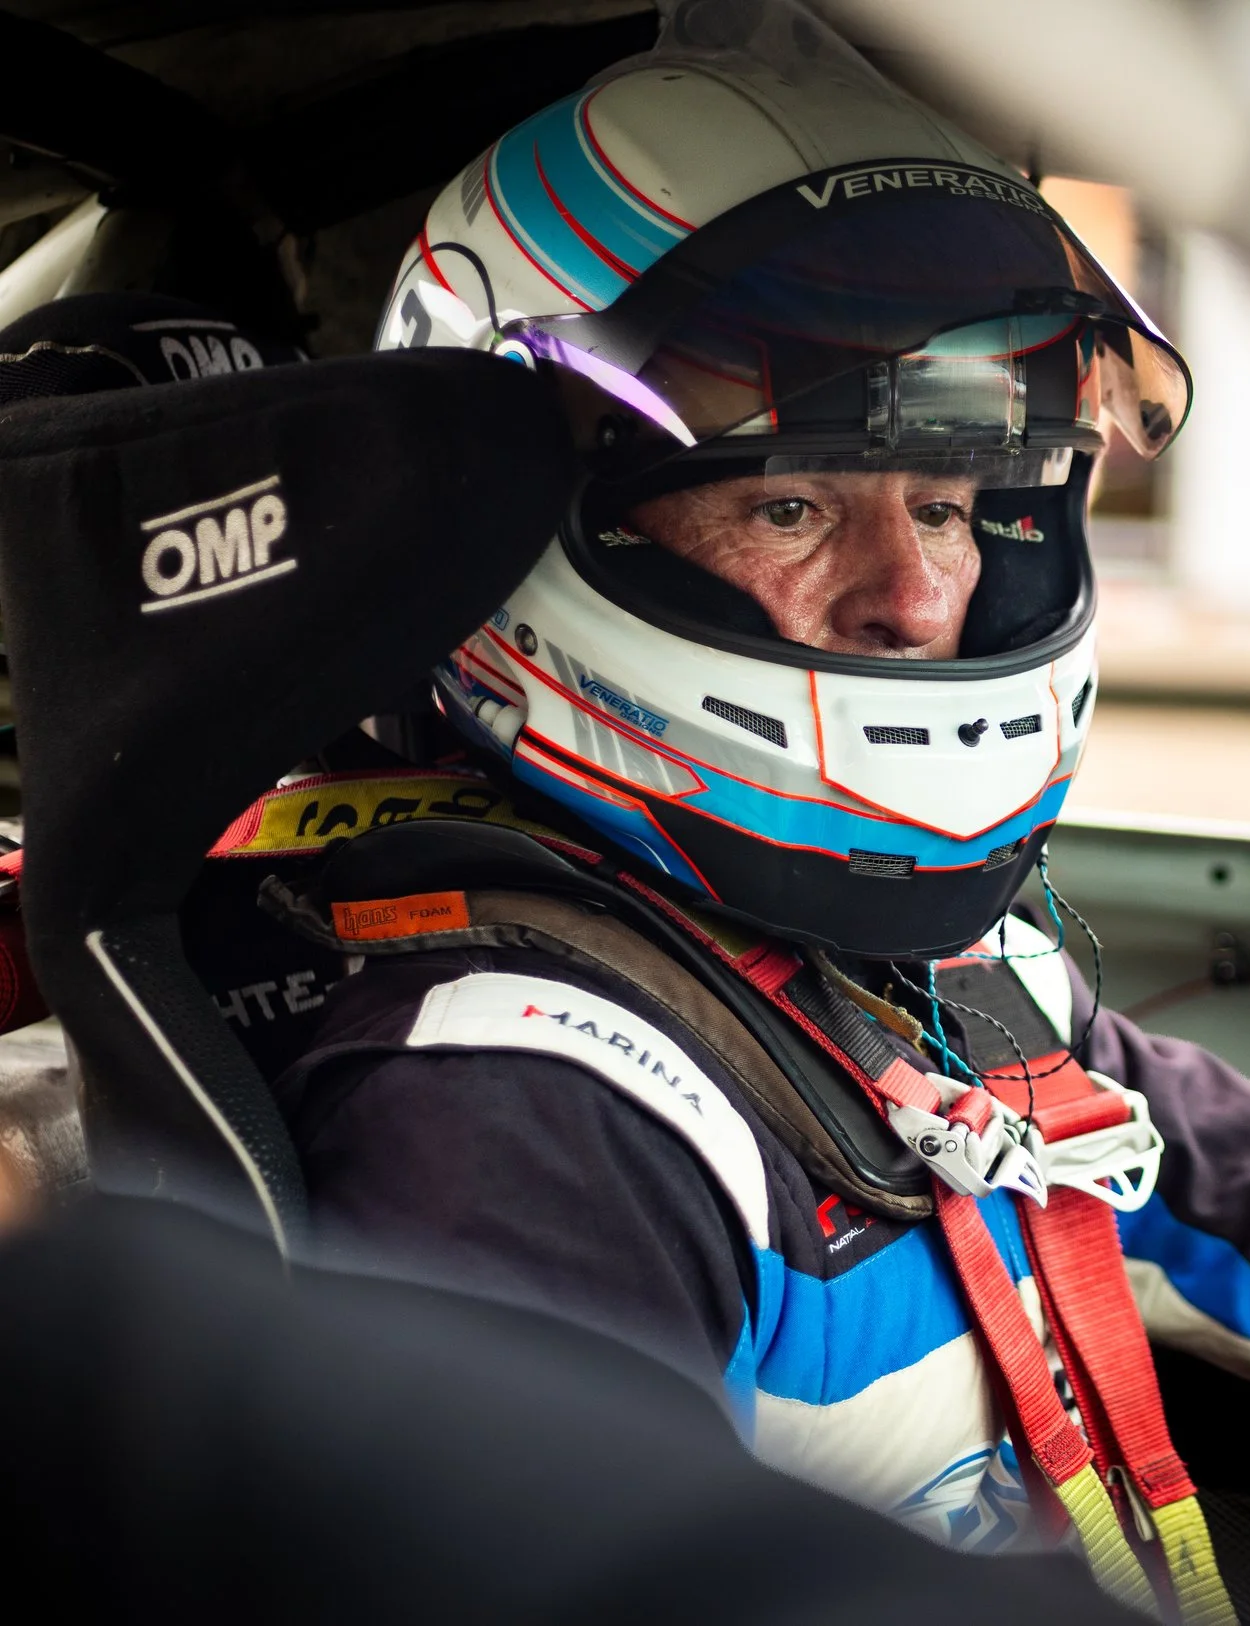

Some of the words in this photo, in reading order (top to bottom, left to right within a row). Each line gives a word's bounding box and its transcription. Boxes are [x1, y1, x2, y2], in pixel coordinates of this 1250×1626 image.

[949, 187, 1053, 220] DESIGNS
[160, 335, 264, 382] OMP
[141, 494, 287, 596] OMP
[409, 905, 452, 921] FOAM
[521, 1004, 704, 1119] MARINA
